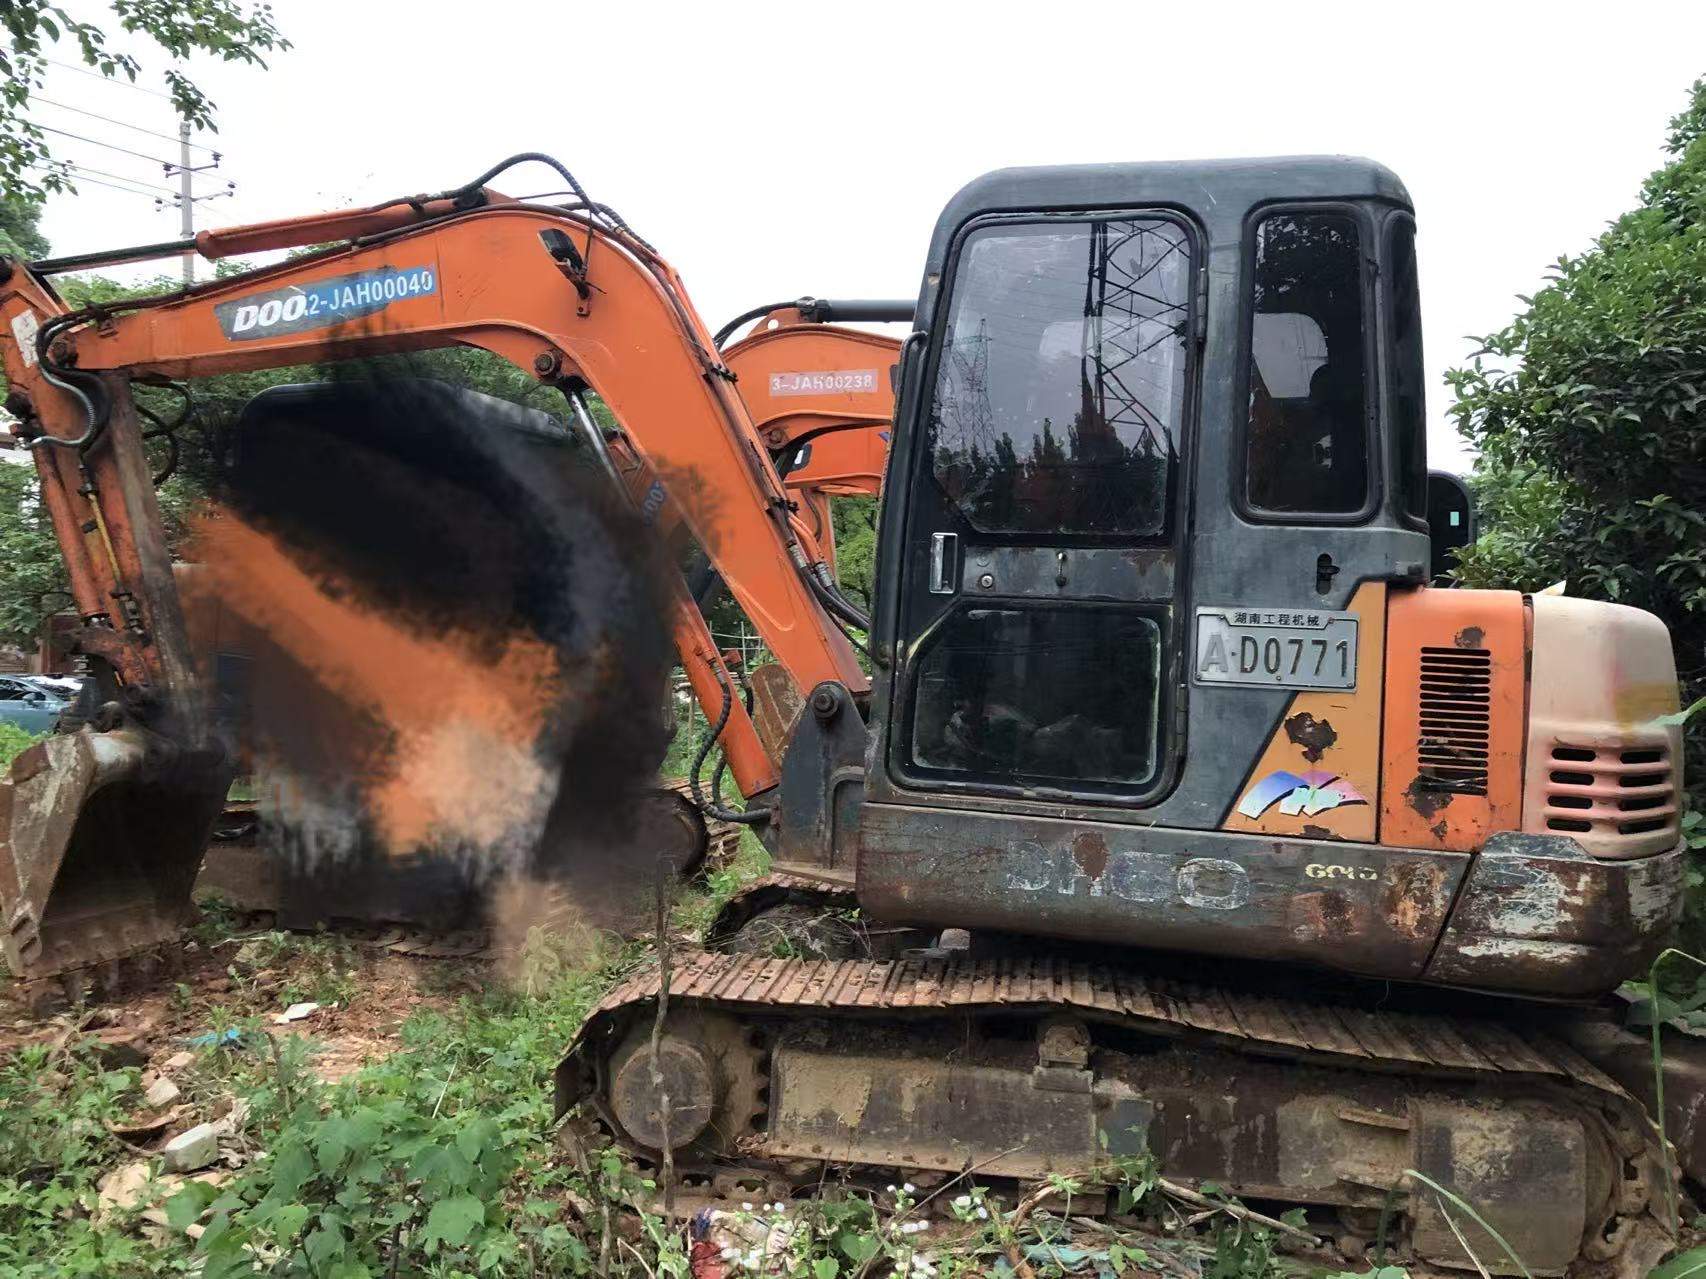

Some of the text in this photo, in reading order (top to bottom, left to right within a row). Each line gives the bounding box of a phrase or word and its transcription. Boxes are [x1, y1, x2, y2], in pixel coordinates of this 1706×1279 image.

[308, 271, 432, 316] 2-JAH00040
[772, 375, 873, 391] 3-JAH00238
[1234, 612, 1320, 627] 湖南工程机械
